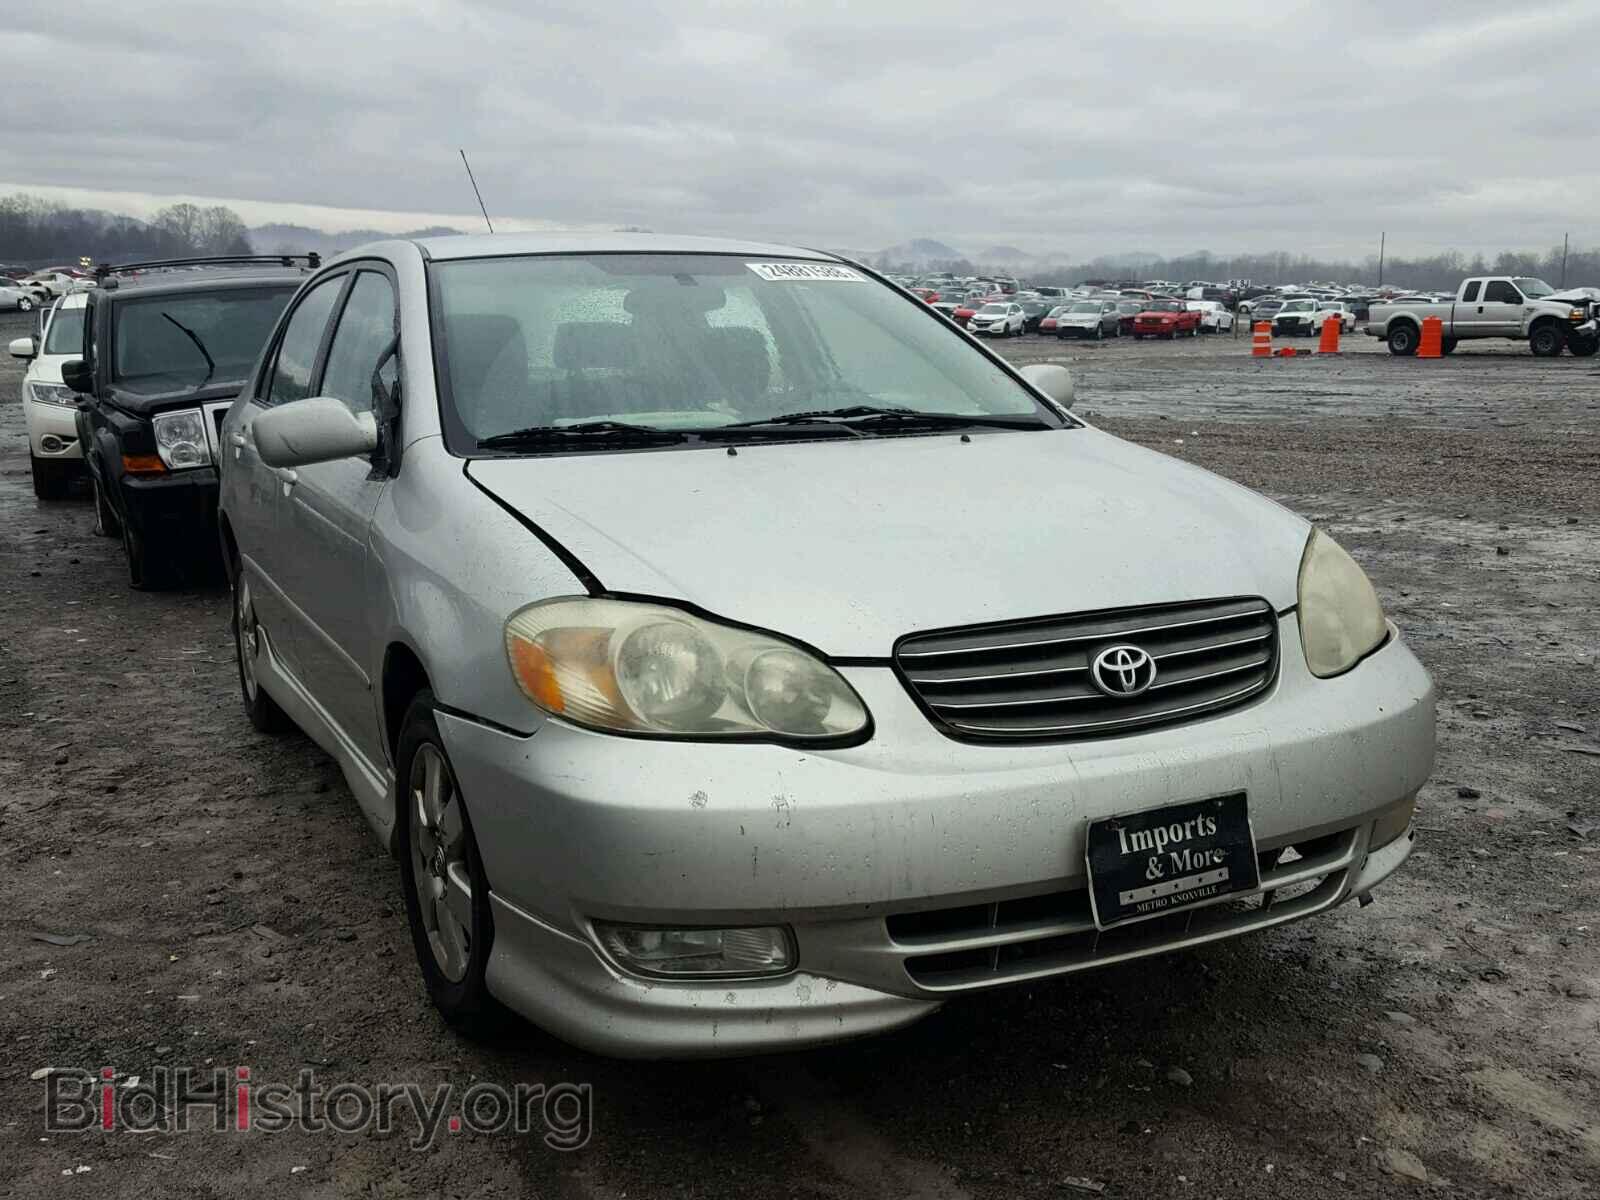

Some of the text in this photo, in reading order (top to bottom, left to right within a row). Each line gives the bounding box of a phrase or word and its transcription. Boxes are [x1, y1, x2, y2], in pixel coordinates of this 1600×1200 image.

[1118, 813, 1217, 855] Imports
[1145, 848, 1225, 880] & More
[1137, 884, 1218, 913] METRO KNOXVILLE
